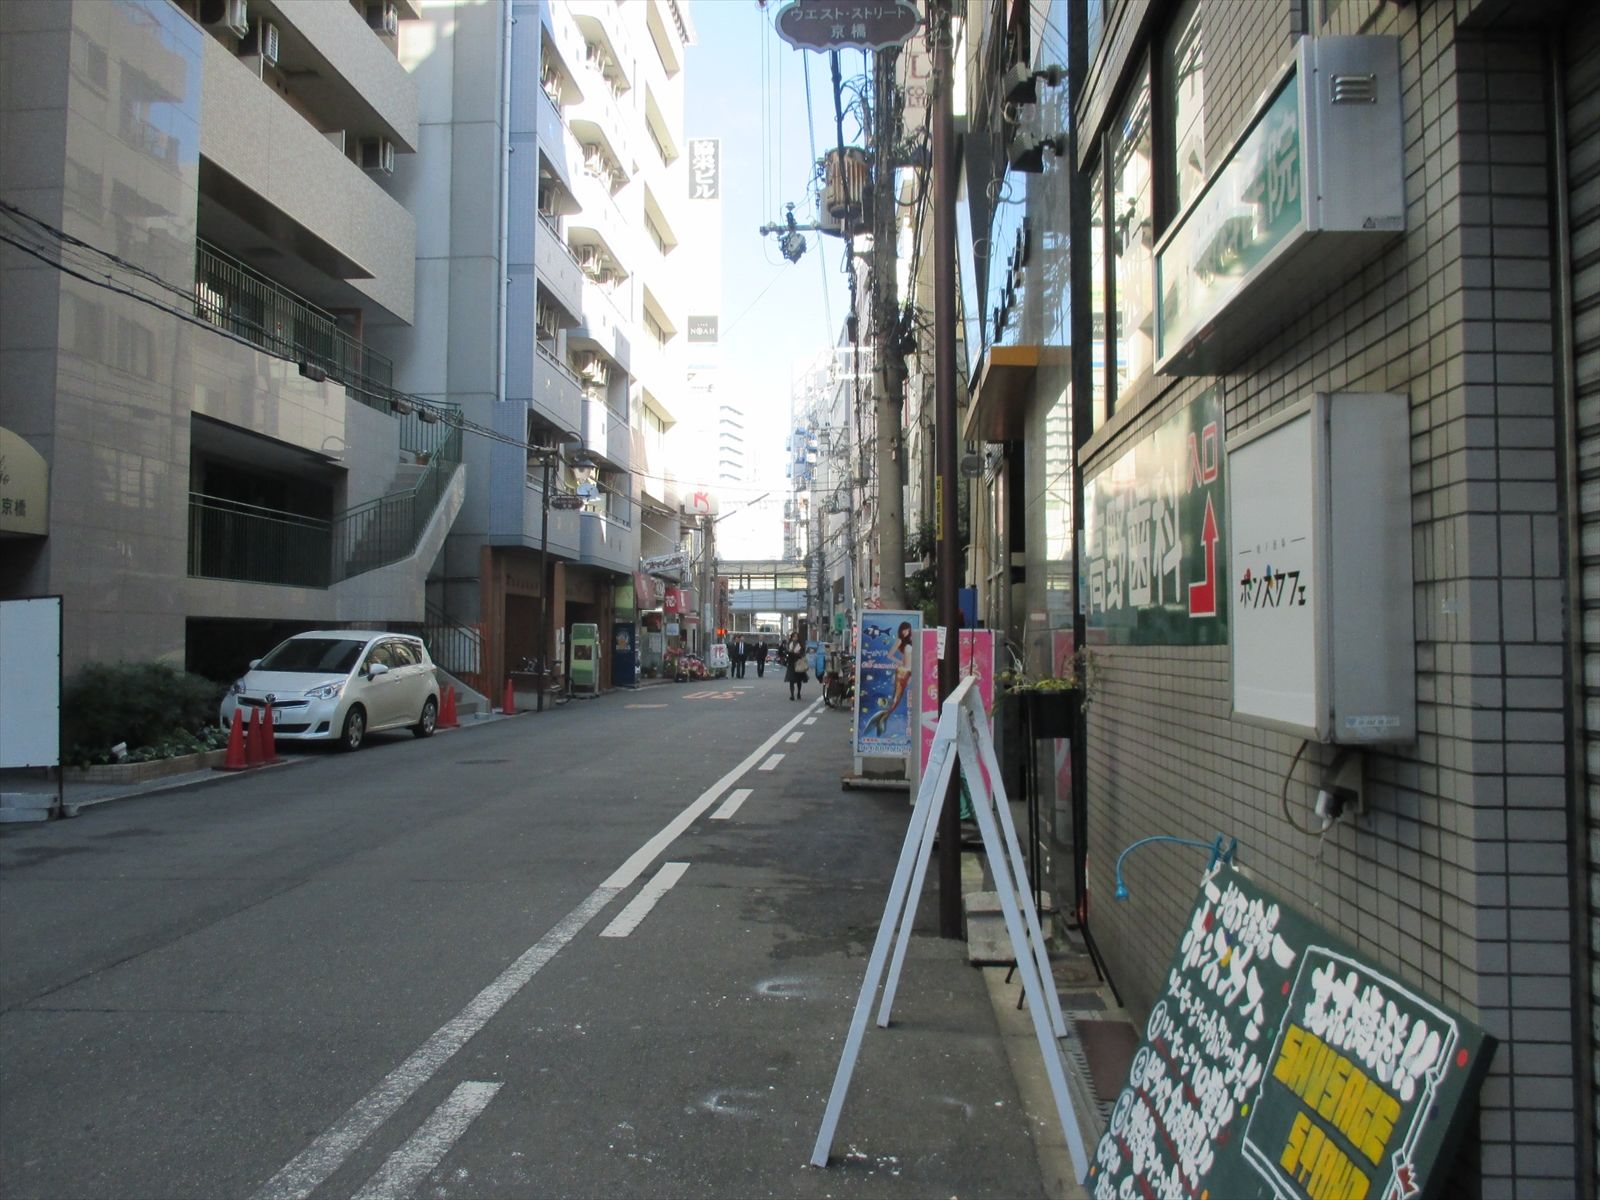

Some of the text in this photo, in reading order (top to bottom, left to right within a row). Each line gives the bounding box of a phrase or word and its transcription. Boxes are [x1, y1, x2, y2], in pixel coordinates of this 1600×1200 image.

[830, 24, 867, 39] 京橋
[1187, 420, 1218, 494] 入口
[1273, 1023, 1402, 1166] SAUSAGE
[1280, 1110, 1371, 1200] STAND
